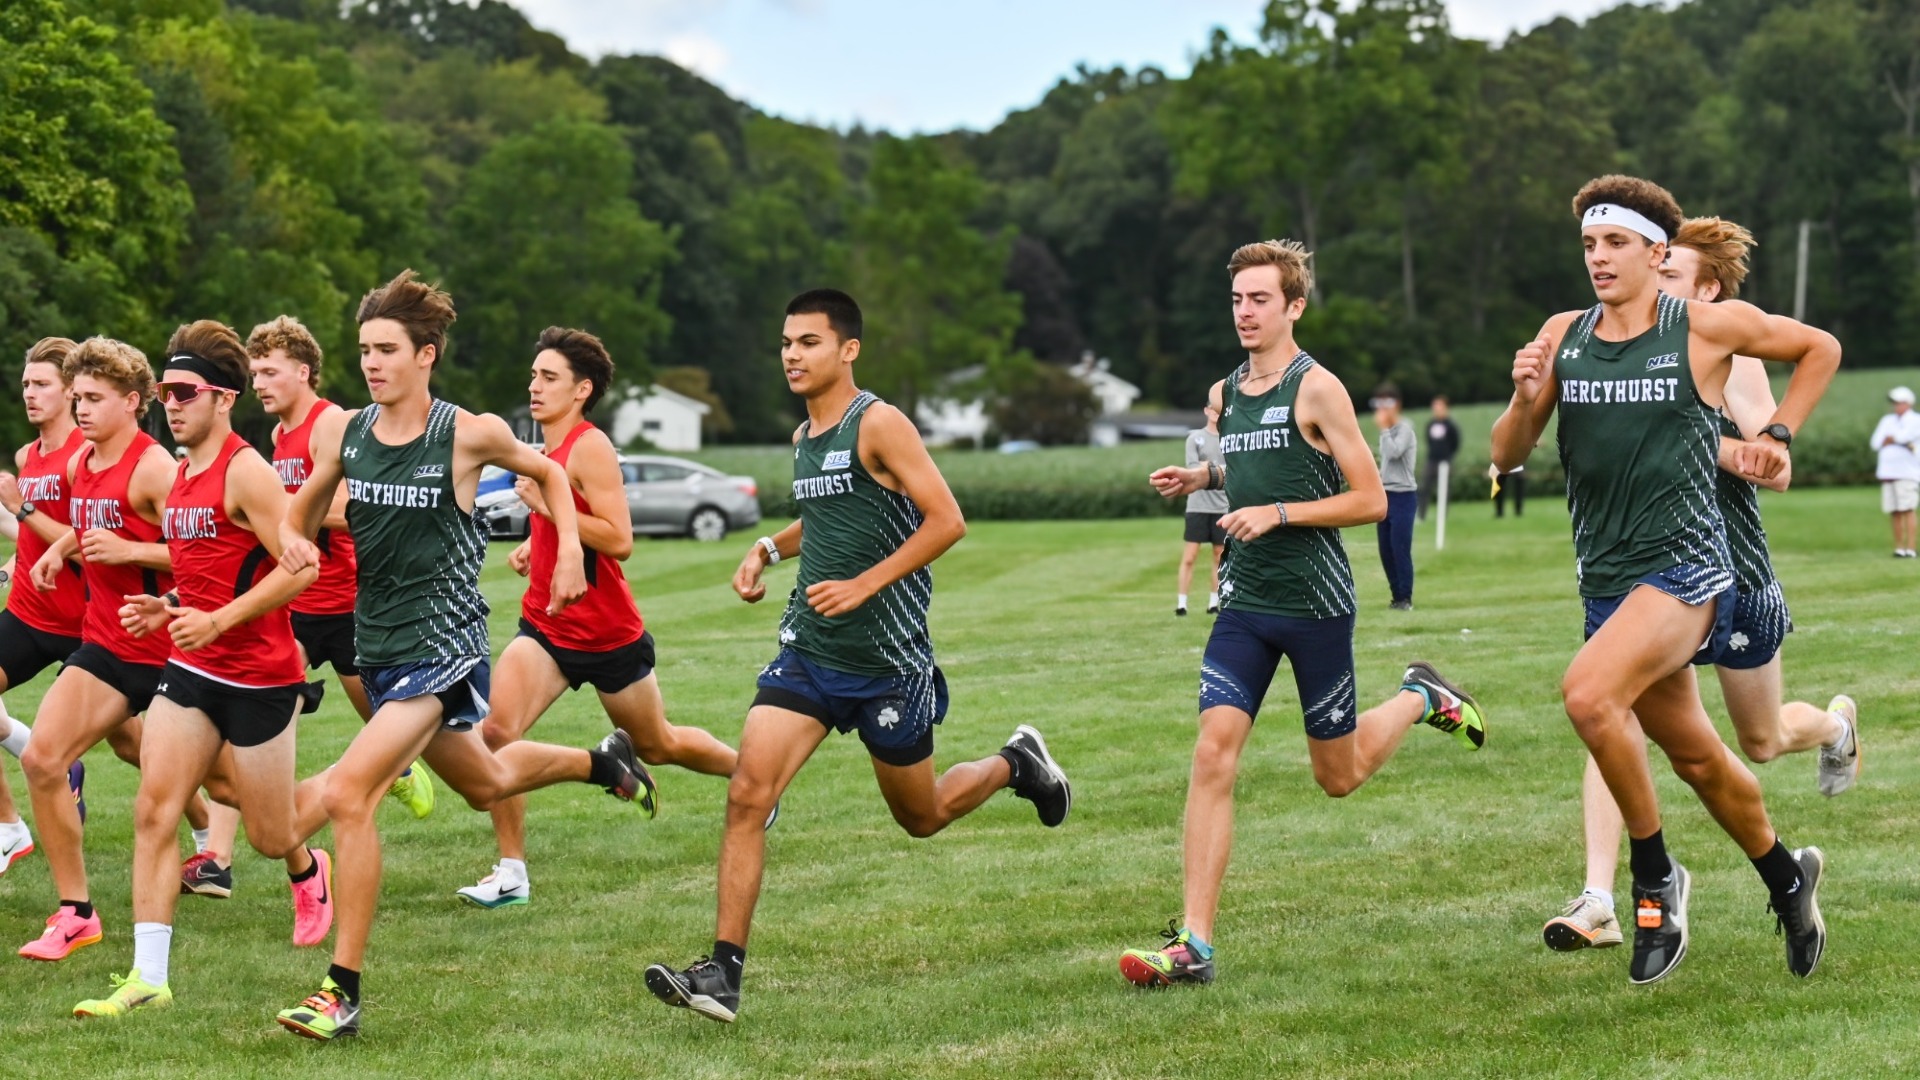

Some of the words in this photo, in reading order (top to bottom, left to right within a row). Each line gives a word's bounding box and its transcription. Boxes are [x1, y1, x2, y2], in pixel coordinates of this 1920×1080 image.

[1646, 353, 1679, 369] NEC
[1562, 378, 1678, 404] MERCYHURST
[1263, 408, 1289, 420] NEC
[824, 452, 850, 466] NEC
[413, 464, 444, 477] NEC
[347, 478, 442, 508] ERCYHURST
